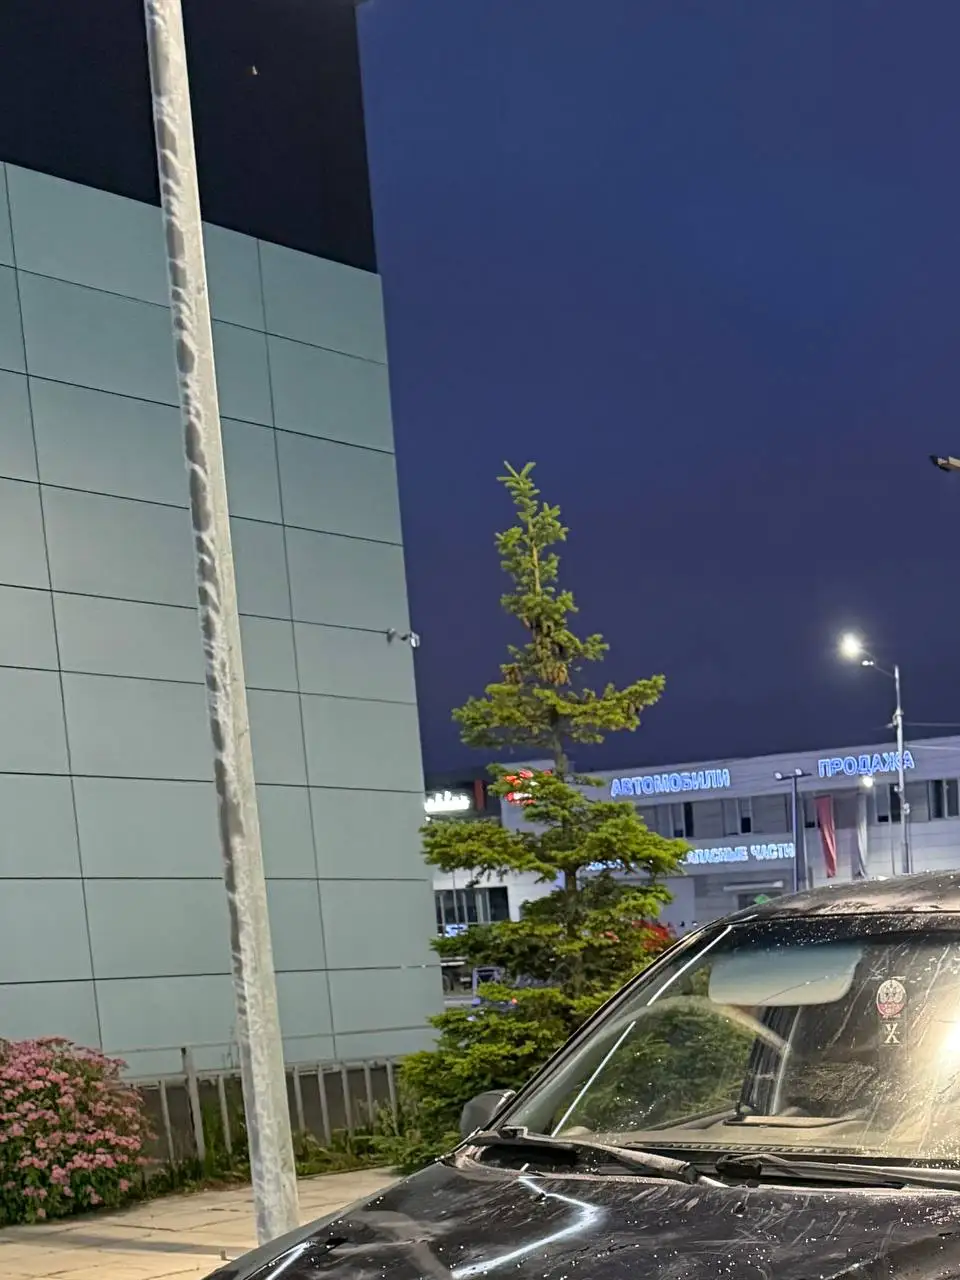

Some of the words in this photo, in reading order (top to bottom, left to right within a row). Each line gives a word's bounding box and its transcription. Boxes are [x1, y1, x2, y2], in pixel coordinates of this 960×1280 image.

[818, 750, 915, 777] ПРОДАЖА
[610, 768, 730, 797] АВТОМОБИЛИ
[679, 845, 749, 865] АПАСНЫЕ
[750, 842, 796, 861] ЧАСТИ
